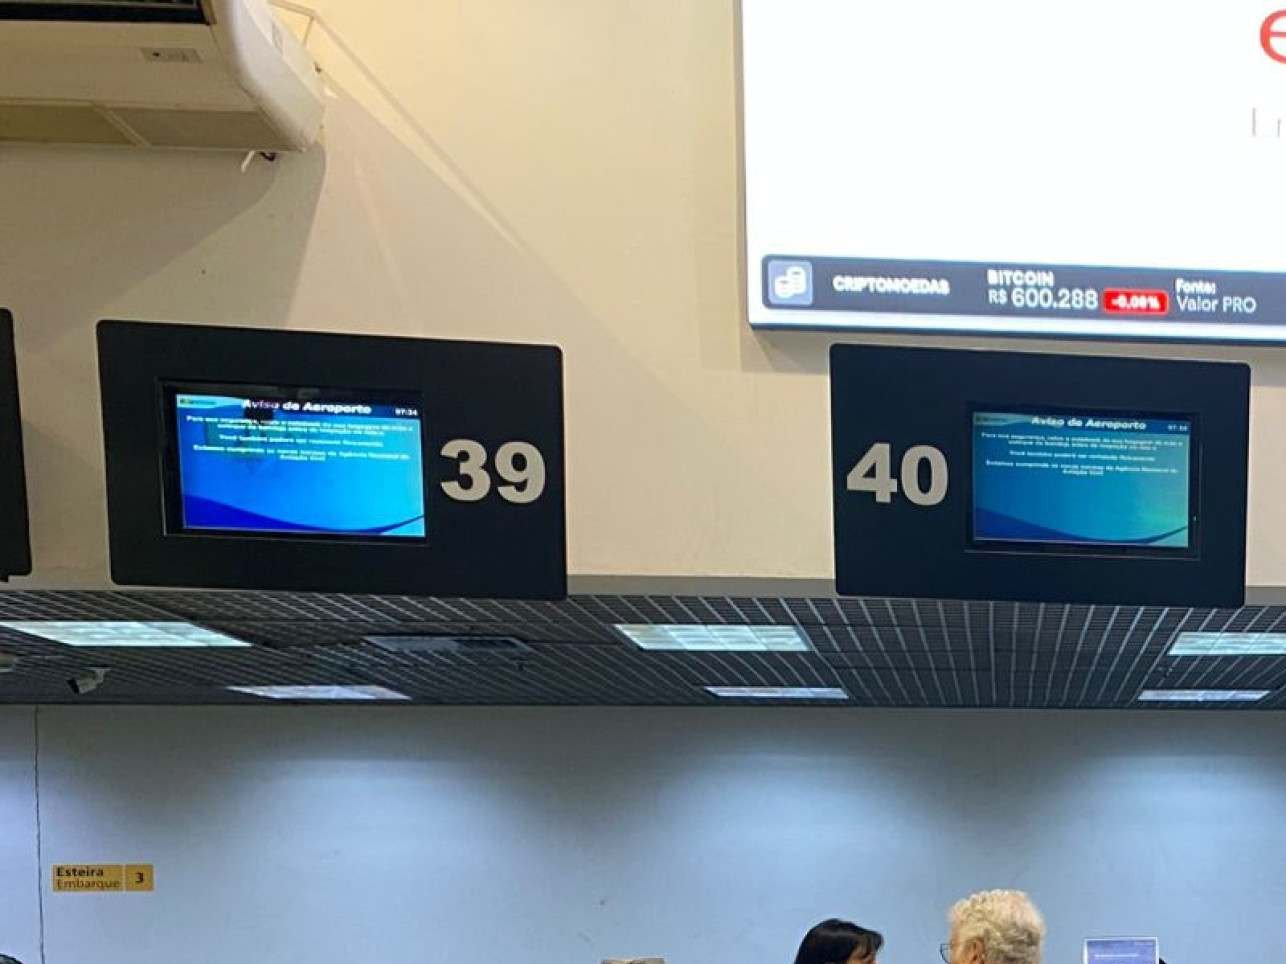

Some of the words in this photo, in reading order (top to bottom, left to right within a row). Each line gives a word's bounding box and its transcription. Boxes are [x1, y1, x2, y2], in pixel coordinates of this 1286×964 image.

[832, 275, 950, 295] CRIPTOMOEDAS
[987, 269, 1054, 287] BITCOIN
[1175, 277, 1216, 295] Fonte:
[988, 289, 1007, 306] R$
[1011, 288, 1098, 310] 600.288
[1176, 294, 1219, 312] Valor
[1222, 296, 1257, 313] PRO
[240, 398, 280, 410] Aviso
[282, 401, 300, 411] de
[301, 401, 372, 415] Aeroporto
[1031, 416, 1065, 427] Aviso
[1067, 418, 1084, 428] de
[1085, 418, 1147, 431] Aeroporto
[439, 438, 547, 504] 39
[846, 442, 949, 506] 40
[57, 866, 104, 877] Esteira
[135, 872, 144, 884] 3
[57, 878, 120, 891] Embarque
